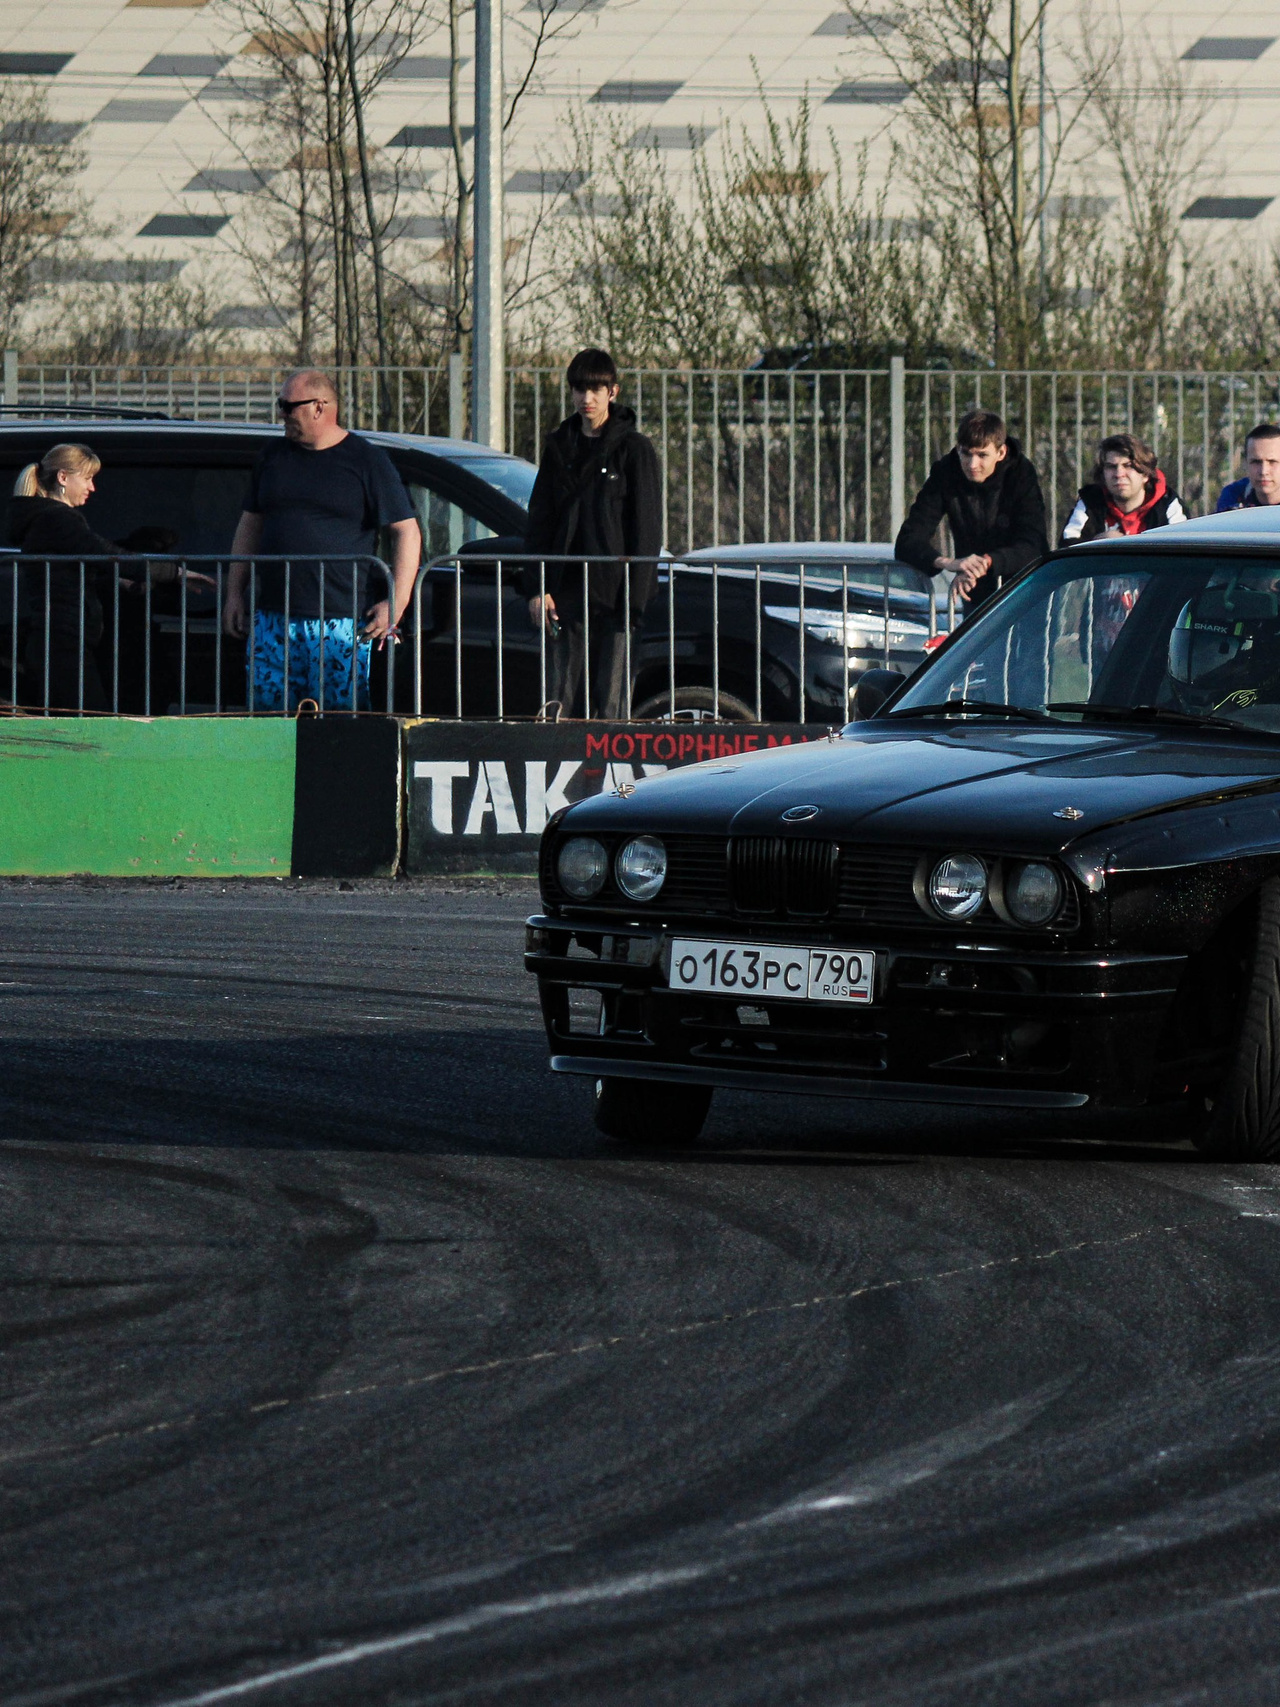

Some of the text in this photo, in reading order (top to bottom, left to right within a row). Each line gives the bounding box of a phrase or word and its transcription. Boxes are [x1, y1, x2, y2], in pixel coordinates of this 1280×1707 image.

[1194, 622, 1228, 634] SHARK
[812, 953, 863, 985] 790
[822, 984, 848, 996] RUS
